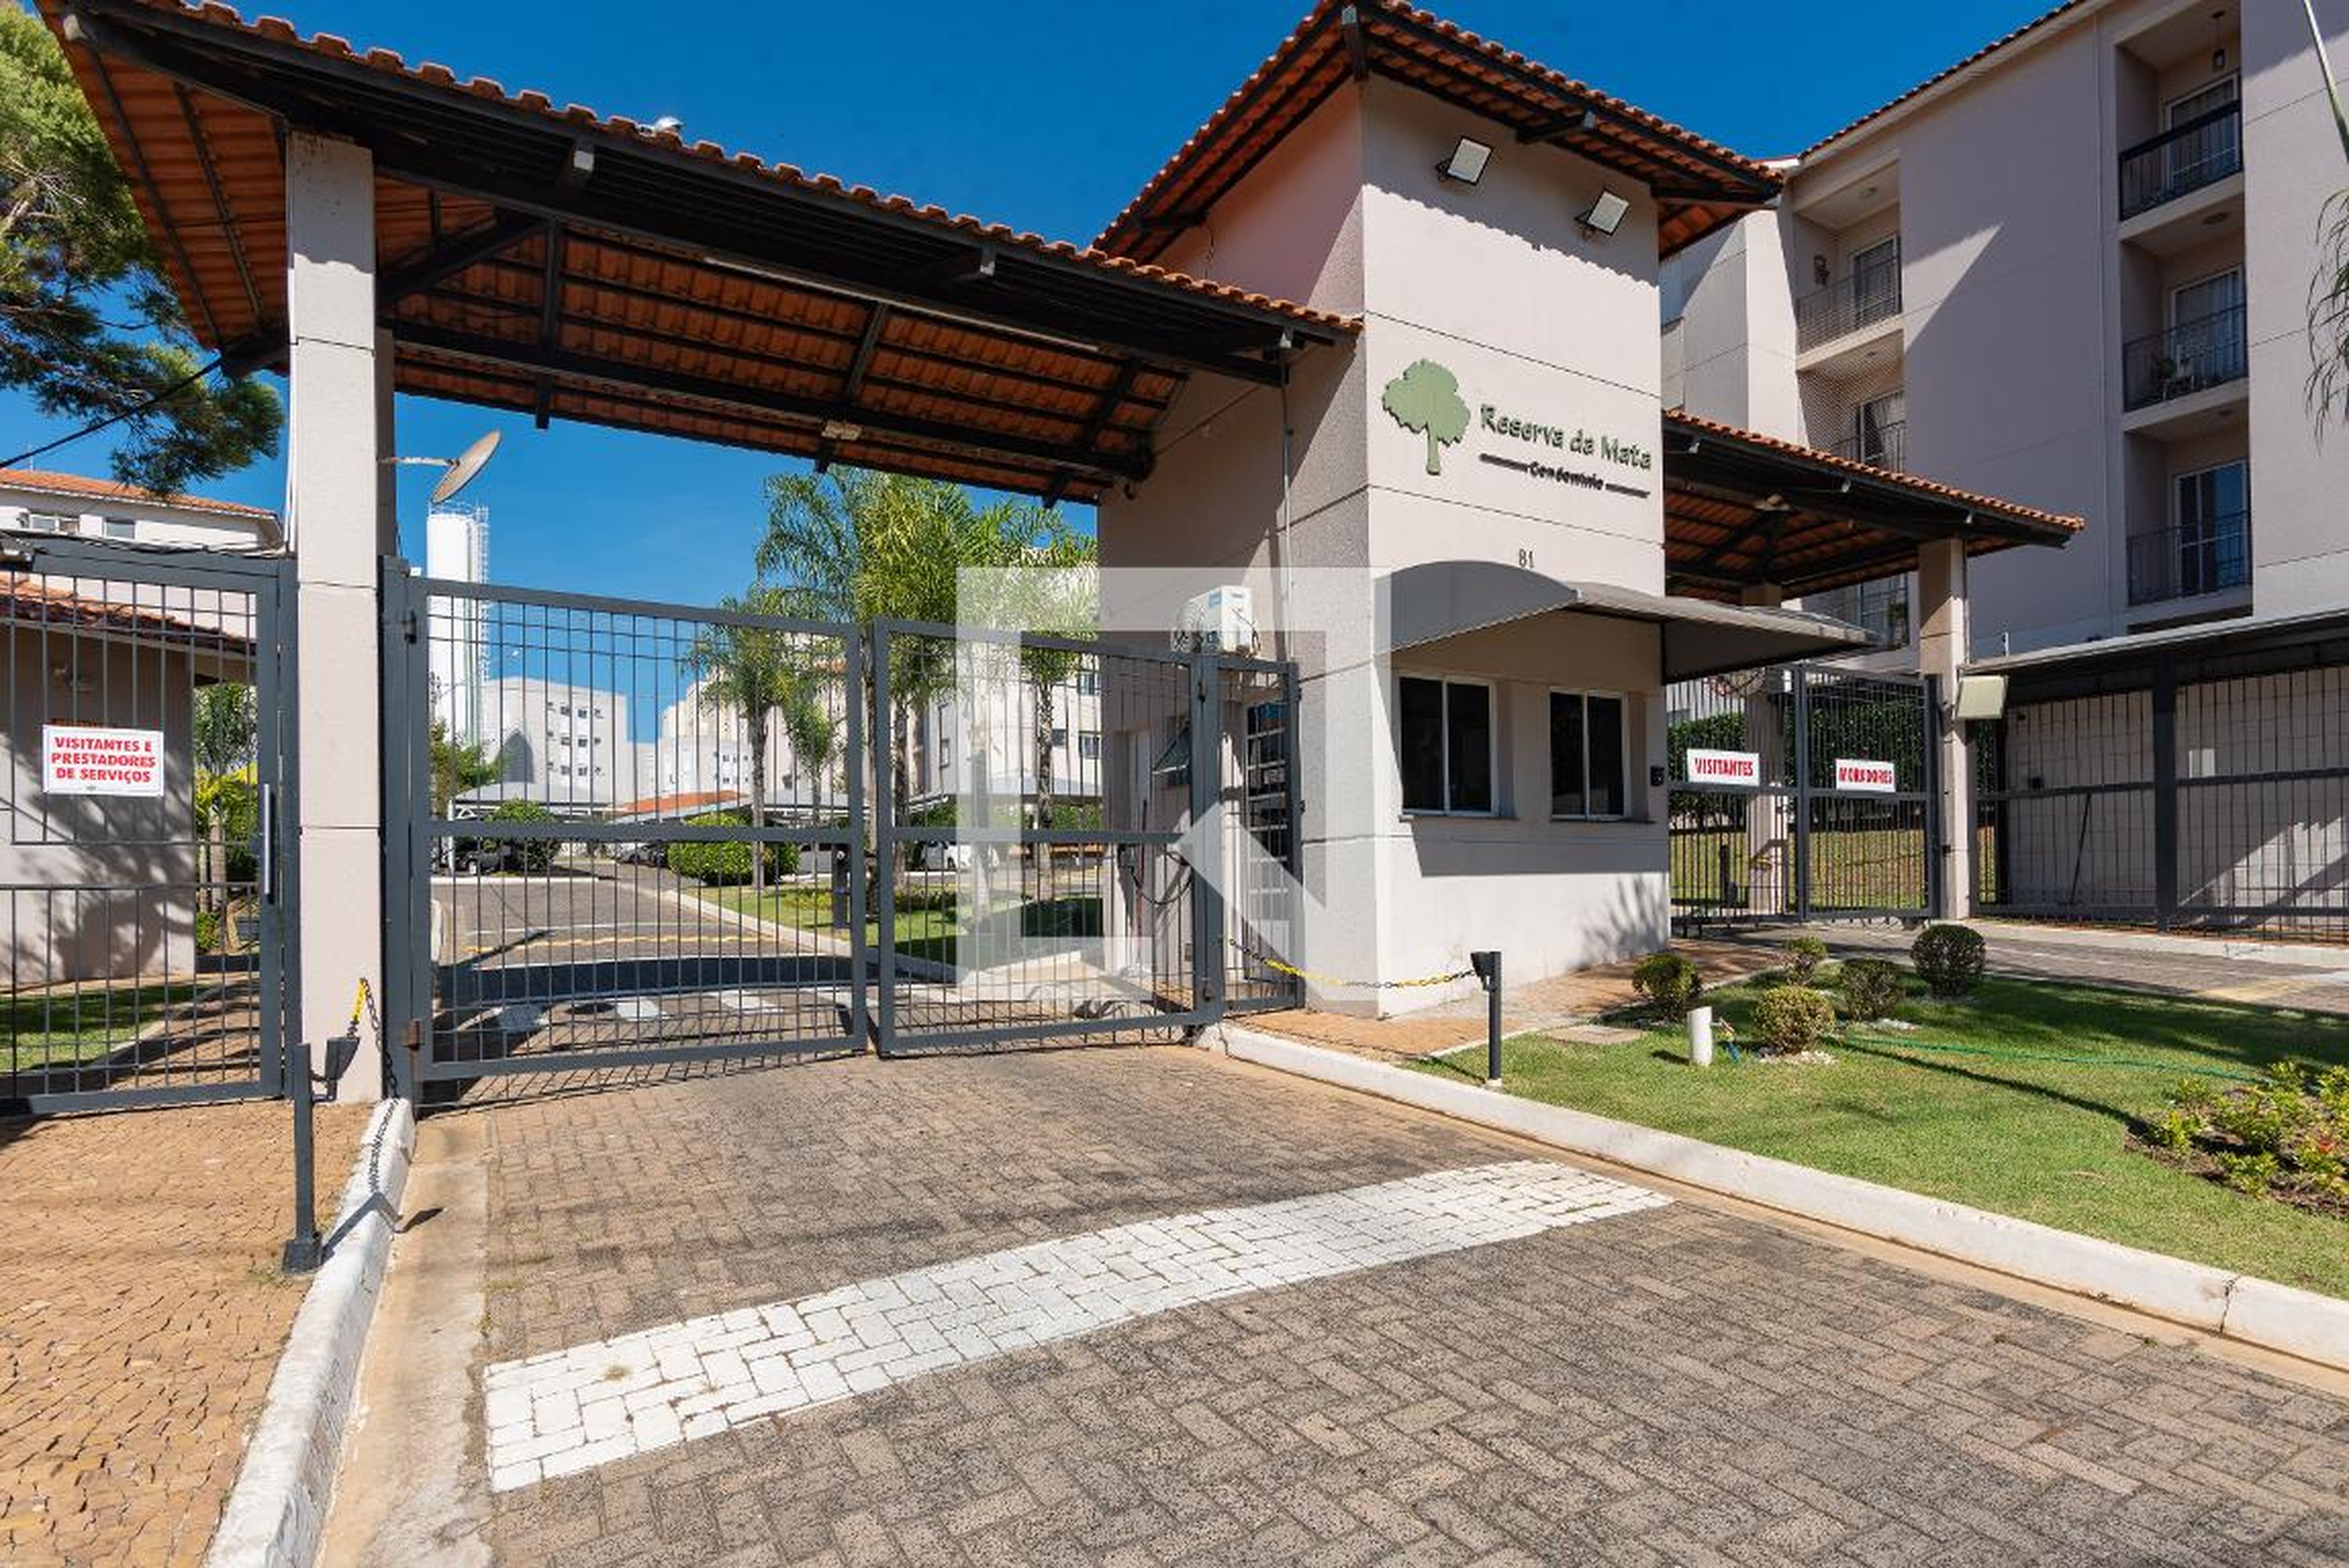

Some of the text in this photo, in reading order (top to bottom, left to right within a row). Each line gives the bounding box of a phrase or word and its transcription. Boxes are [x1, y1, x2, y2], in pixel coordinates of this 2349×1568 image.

[1480, 404, 1651, 470] Reserva da Mata
[54, 737, 152, 752] VISITANTES E
[51, 753, 155, 768] PRESTADORES
[1694, 758, 1753, 777] VISITANTES
[56, 767, 151, 784] DE SERVIÇOS
